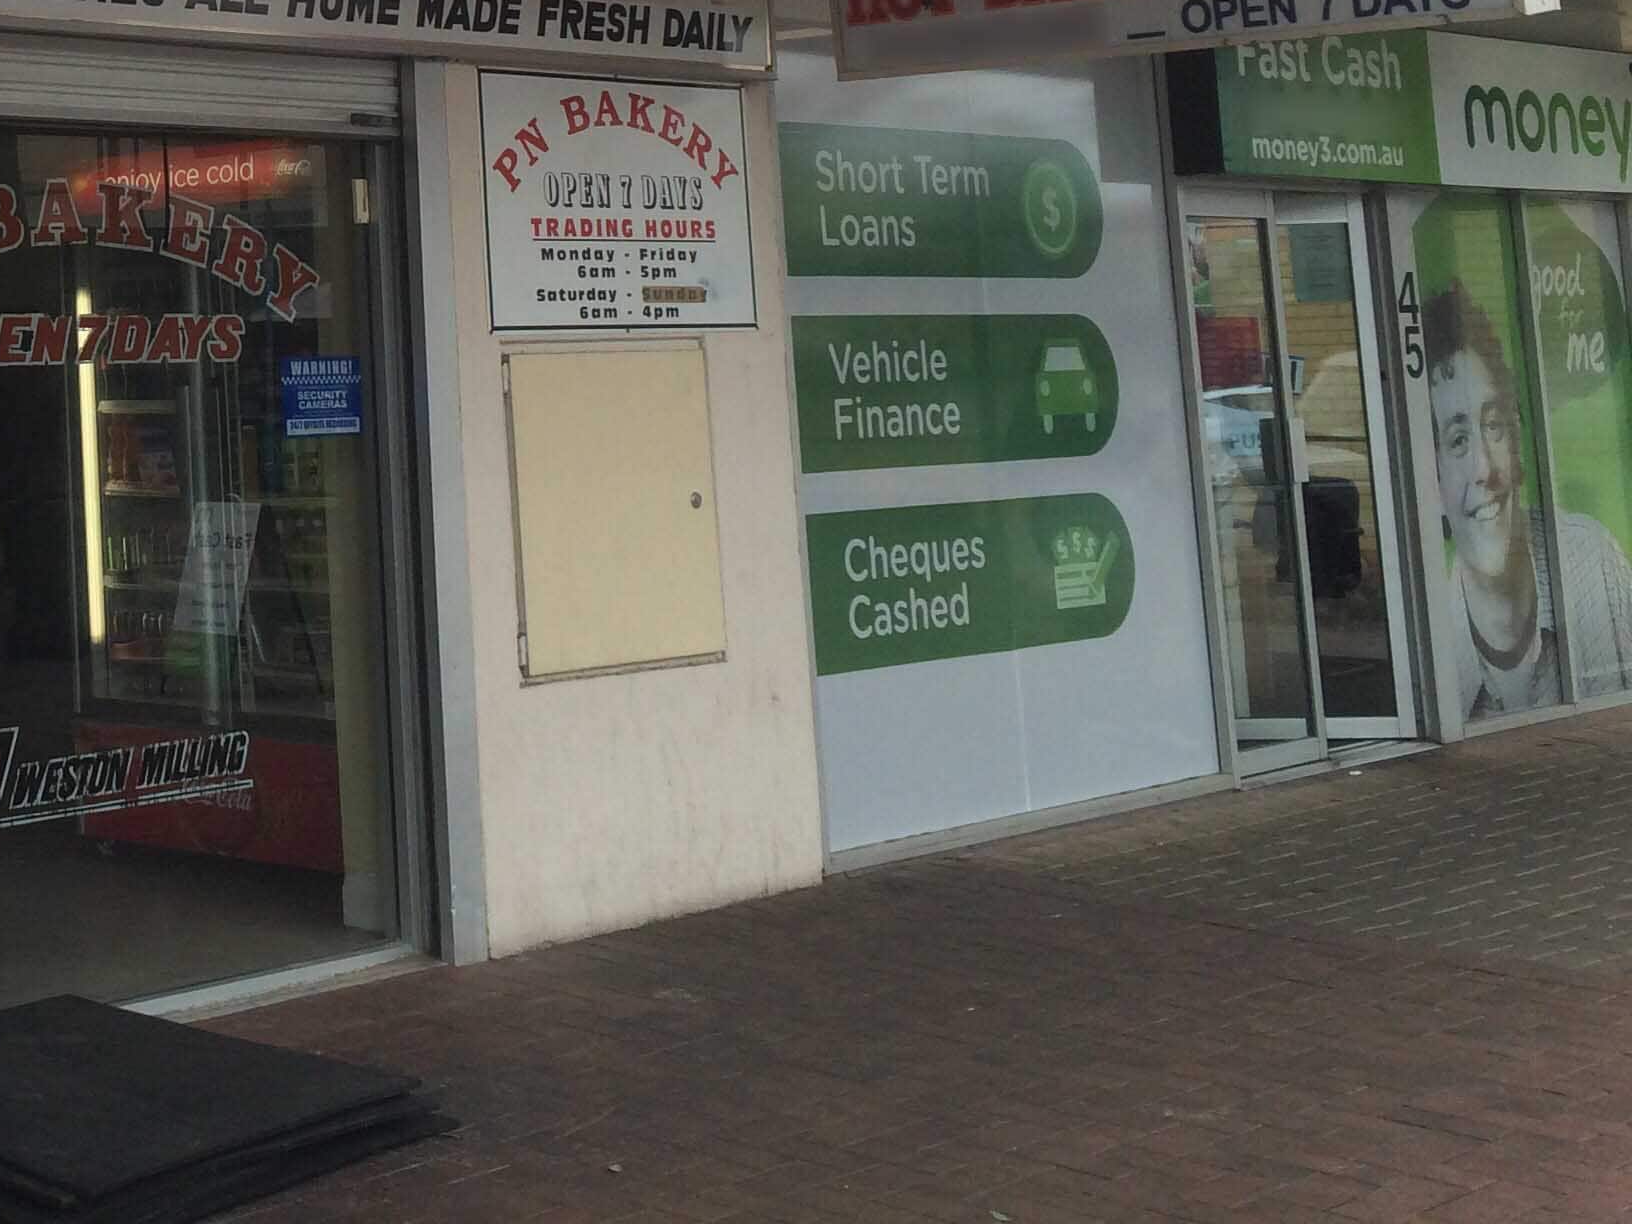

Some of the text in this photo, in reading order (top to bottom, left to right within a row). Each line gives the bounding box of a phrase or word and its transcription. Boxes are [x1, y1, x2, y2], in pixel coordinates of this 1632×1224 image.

[662, 8, 754, 53] DAILY
[1235, 34, 1403, 92] Fast Cash
[491, 89, 739, 193] PN BAKERY
[1251, 135, 1405, 169] money3.com.au
[1464, 84, 1632, 185] money
[169, 164, 199, 189] ice
[206, 152, 255, 185] cold
[542, 171, 704, 210] OPEN 7 DAYS
[814, 149, 992, 199] Short Term
[530, 217, 716, 239] TRADING HOURS
[818, 205, 917, 248] Loans
[540, 247, 616, 263] Monday
[639, 247, 698, 264] Friday
[577, 265, 617, 279] 6am
[640, 265, 678, 281] 5pm
[536, 287, 618, 303] Saturday
[579, 305, 619, 320] 6am
[642, 305, 680, 321] 4pm
[76, 315, 106, 366] 7
[104, 313, 247, 365] DAYS
[1566, 330, 1606, 373] me
[289, 359, 353, 376] WARNING!
[827, 339, 948, 386] Vehicle
[296, 390, 348, 401] SECURITY
[297, 399, 348, 410] CAMERAS
[832, 396, 962, 442] Finance
[843, 533, 986, 588] Cheques
[848, 581, 971, 640] Cashed
[8, 729, 251, 810] WESTON MILLING
